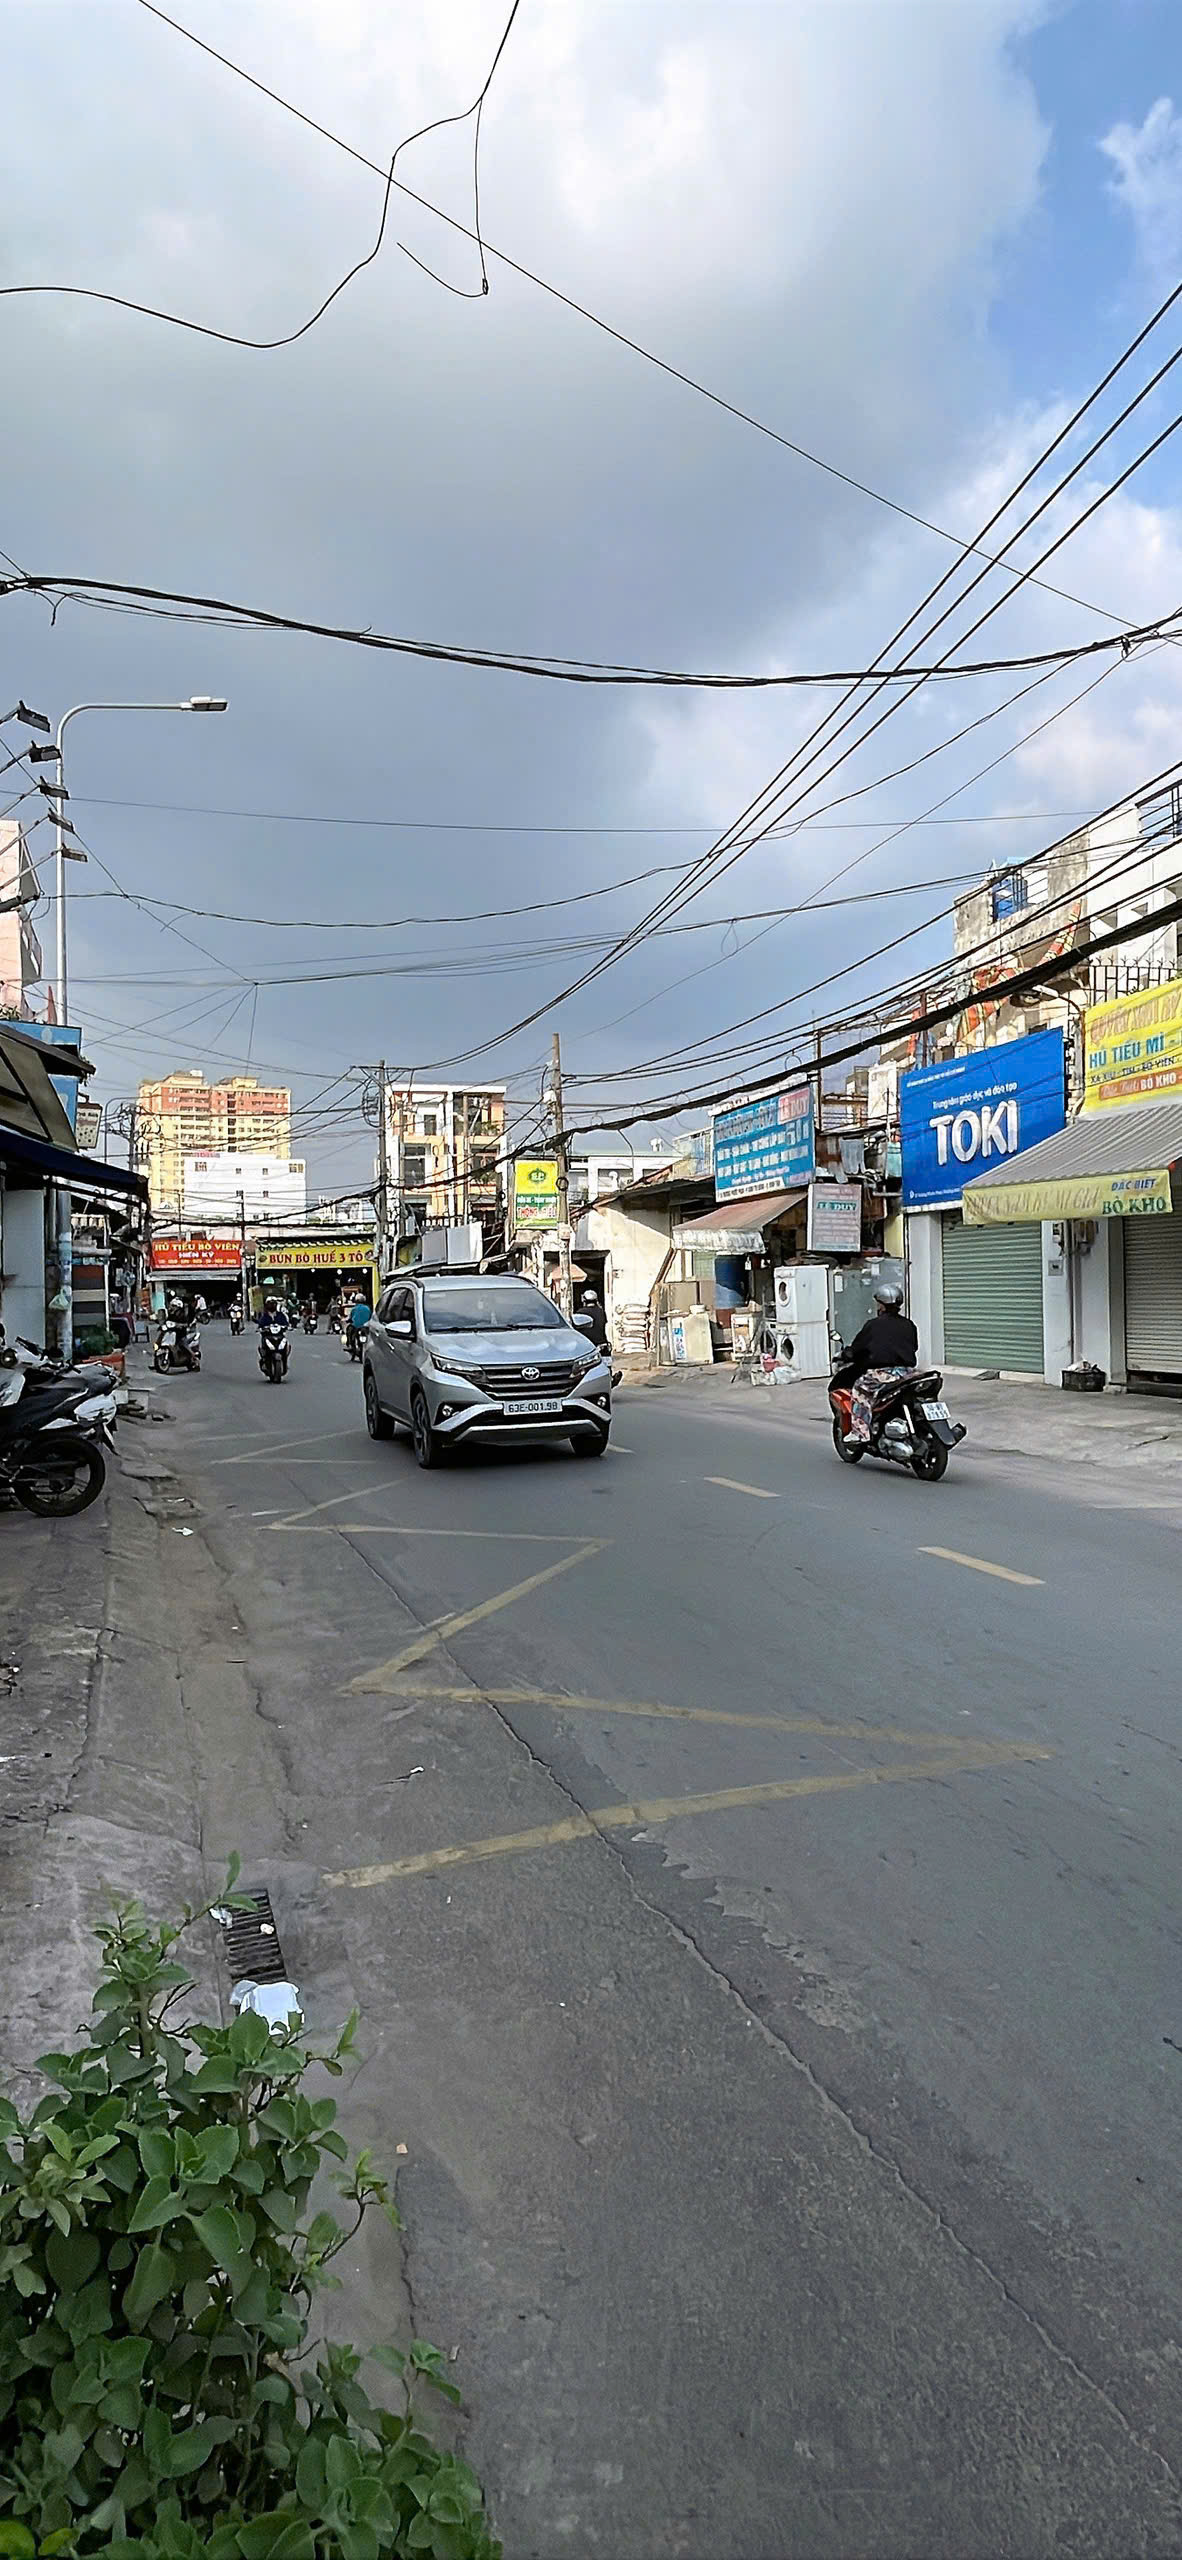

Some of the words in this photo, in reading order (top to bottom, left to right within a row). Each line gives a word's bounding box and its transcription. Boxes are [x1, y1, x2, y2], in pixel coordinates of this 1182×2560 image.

[1155, 1071, 1177, 1088] KHO
[929, 1099, 1018, 1166] TOKI
[1102, 1195, 1124, 1215] BÒ
[1129, 1196, 1167, 1214] KHO
[269, 1252, 292, 1264] BÚN
[313, 1249, 337, 1263] HUẾ
[339, 1253, 346, 1263] 3
[508, 1401, 558, 1413] 63E-001.98
